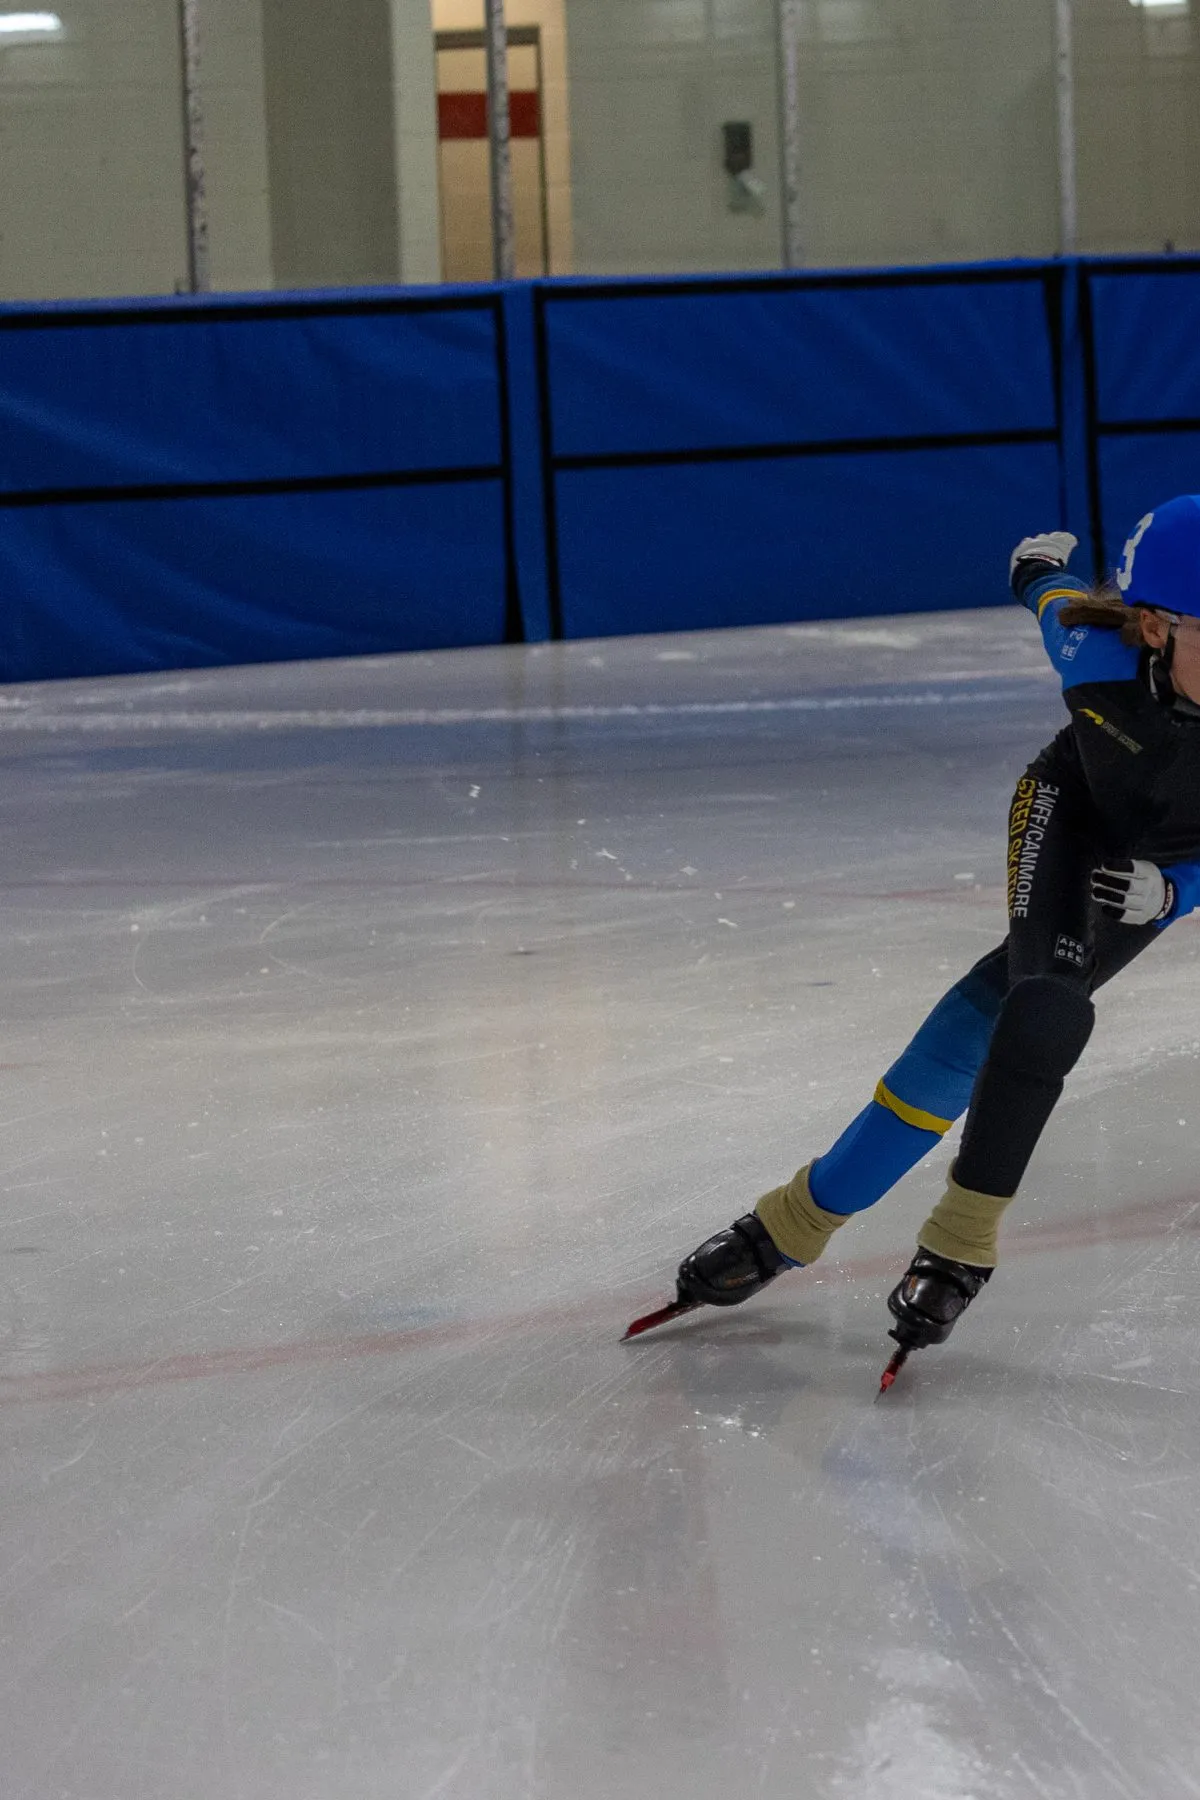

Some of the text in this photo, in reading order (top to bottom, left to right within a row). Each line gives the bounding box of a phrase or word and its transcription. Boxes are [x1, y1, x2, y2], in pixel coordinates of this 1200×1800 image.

[1116, 512, 1154, 591] 3
[1059, 937, 1084, 954] APO
[1057, 949, 1083, 964] GEE
